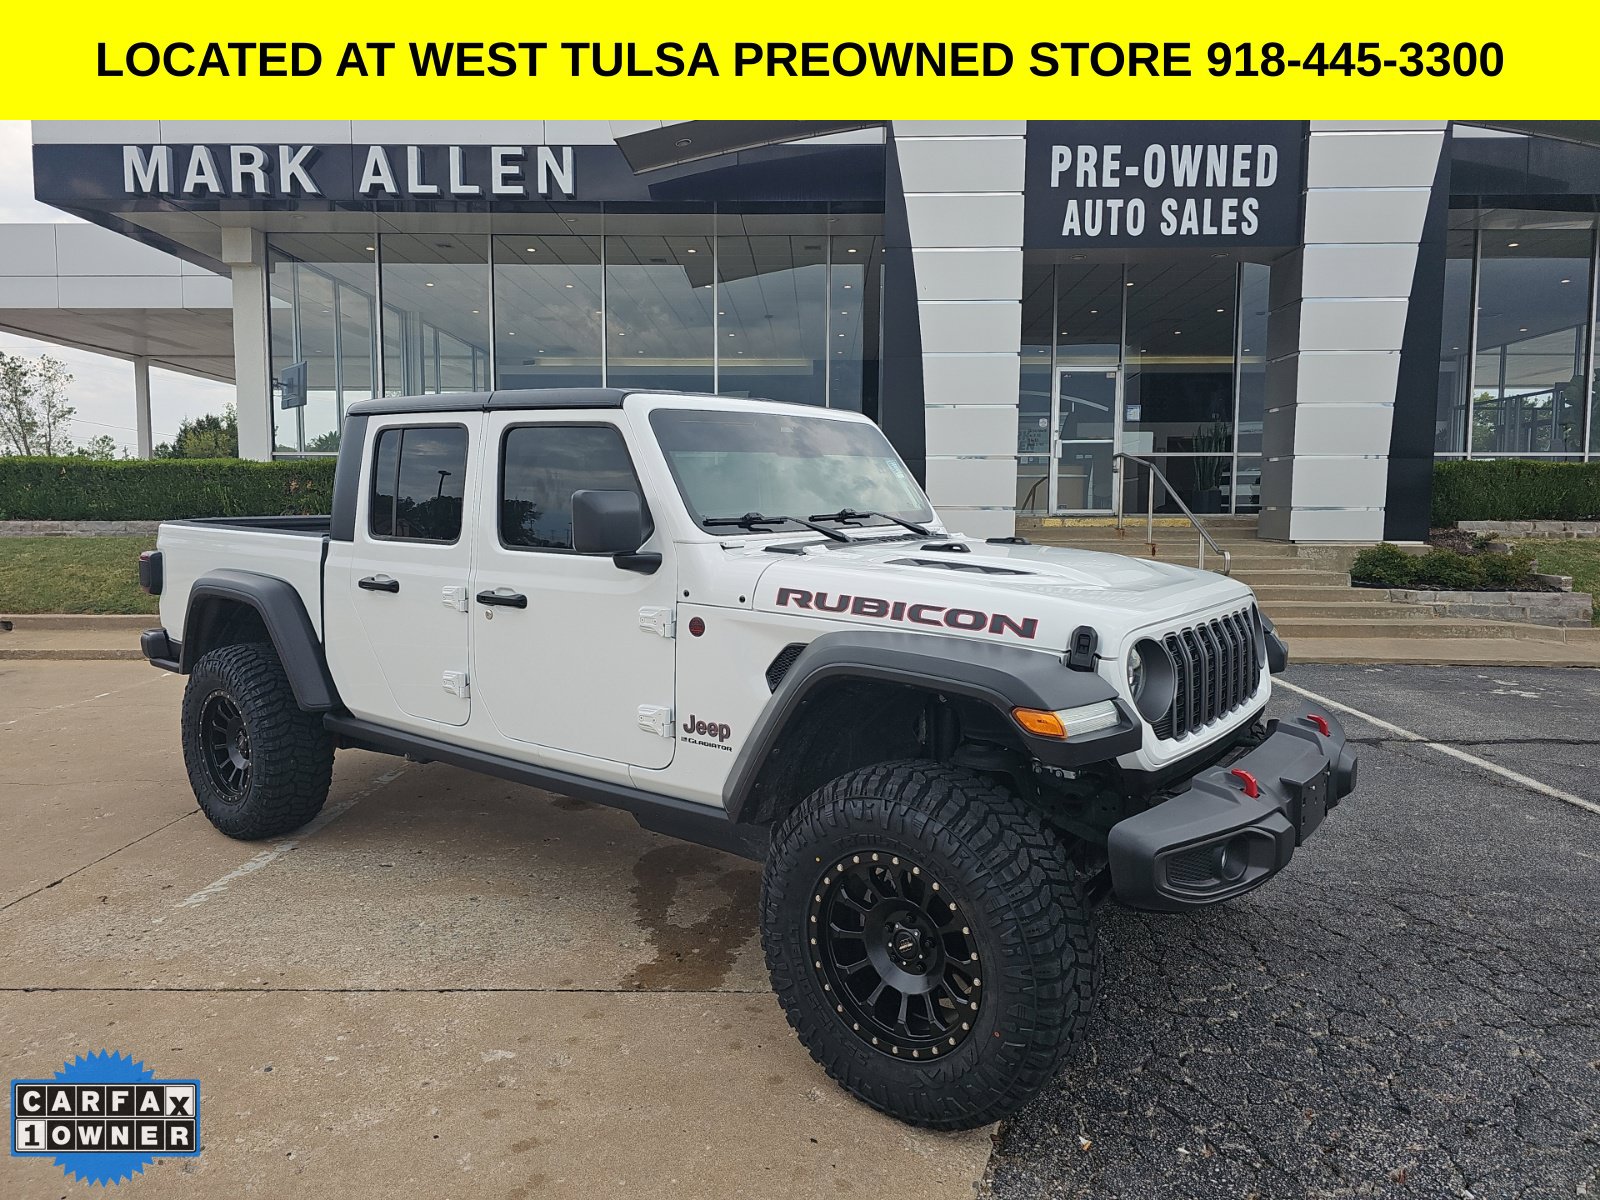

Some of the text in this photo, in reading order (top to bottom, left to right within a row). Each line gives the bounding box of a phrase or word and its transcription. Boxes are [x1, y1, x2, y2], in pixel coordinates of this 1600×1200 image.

[122, 144, 577, 196] MARK ALLEN
[1050, 143, 1279, 188] PRE-OWNED
[1061, 197, 1260, 237] AUTO SALES
[776, 587, 1039, 640] RUBICON
[682, 714, 731, 743] Jeep
[688, 737, 733, 752] GLADIATOR
